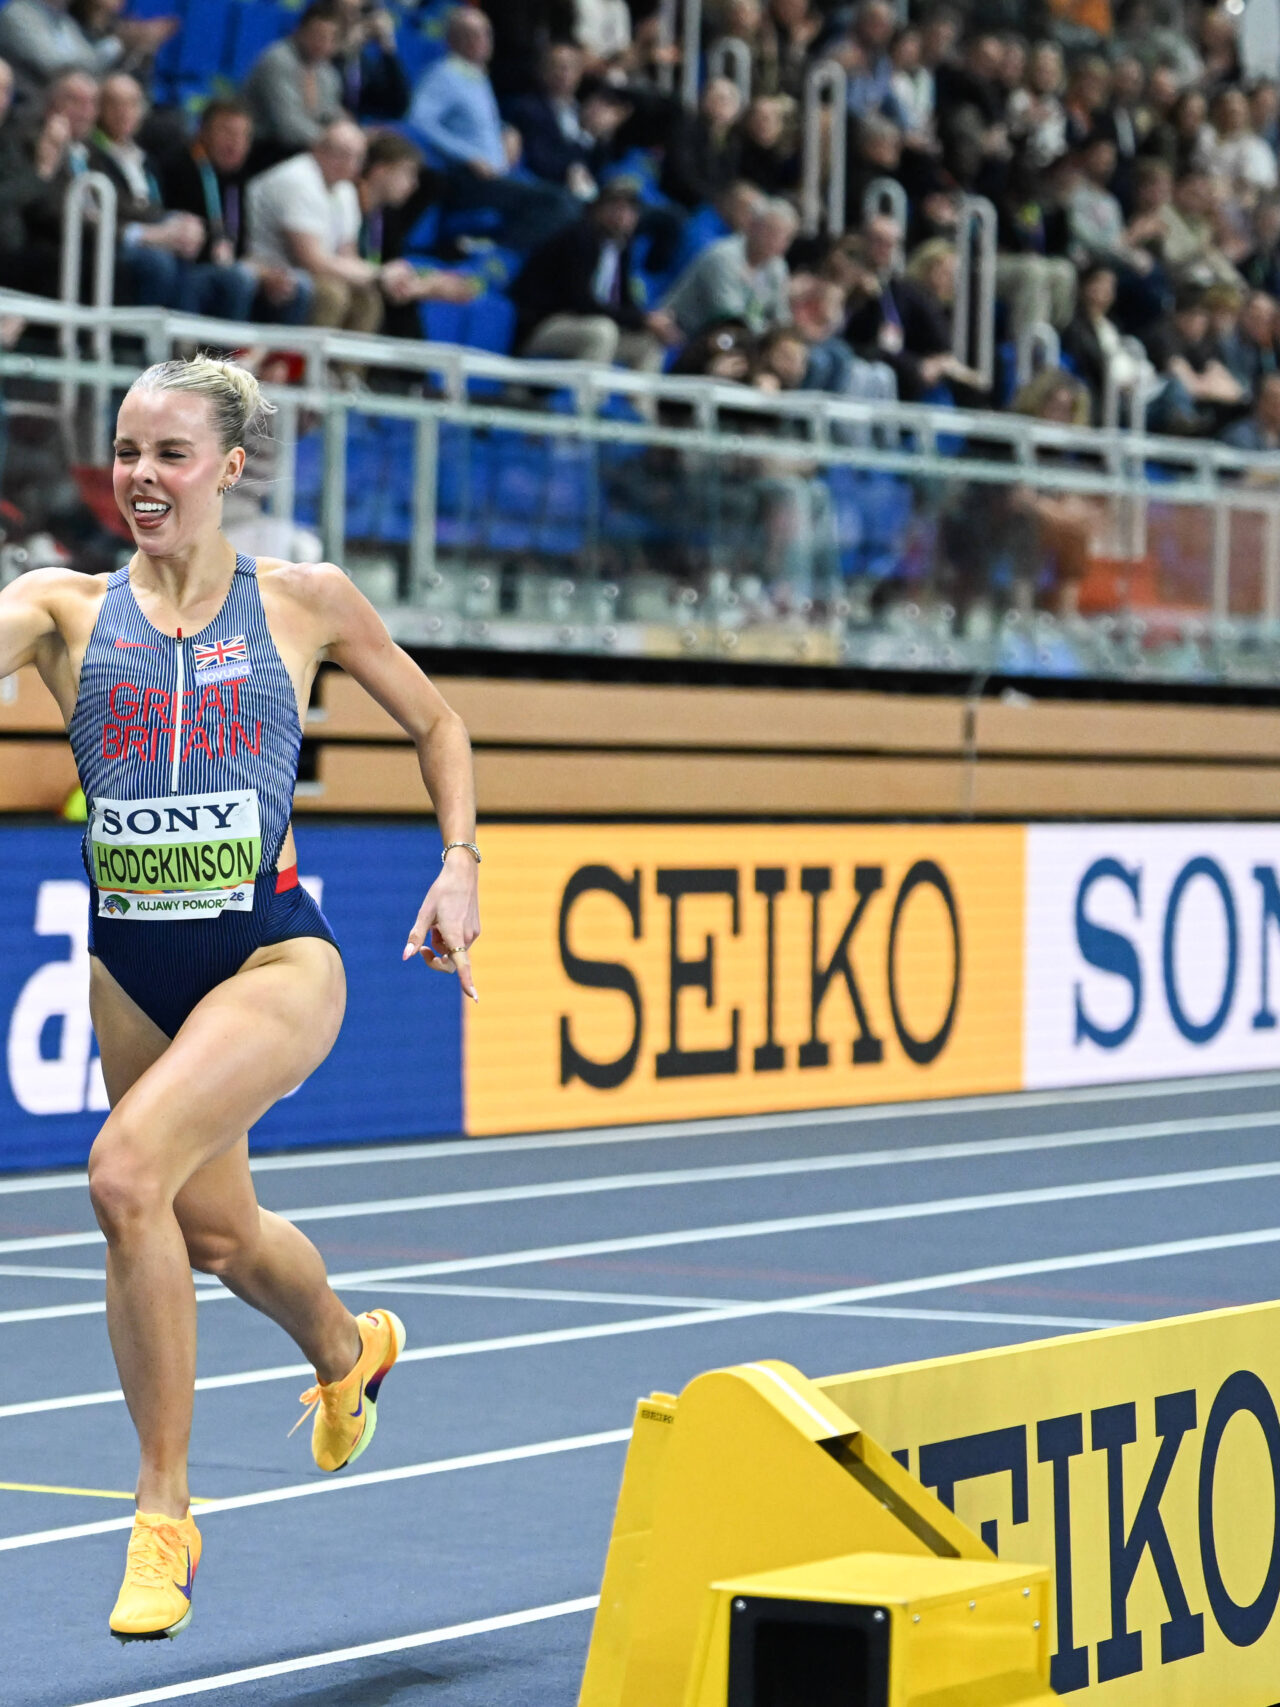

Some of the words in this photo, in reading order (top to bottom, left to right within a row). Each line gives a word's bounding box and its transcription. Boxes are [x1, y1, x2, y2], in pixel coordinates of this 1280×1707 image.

[197, 664, 251, 684] Novuna
[109, 678, 247, 725] GREAT
[102, 721, 262, 763] BRITAIN
[102, 802, 240, 836] SONY
[97, 840, 254, 885] HODGKINSON
[137, 900, 181, 911] KUJAWY
[557, 859, 962, 1090] SEIKO
